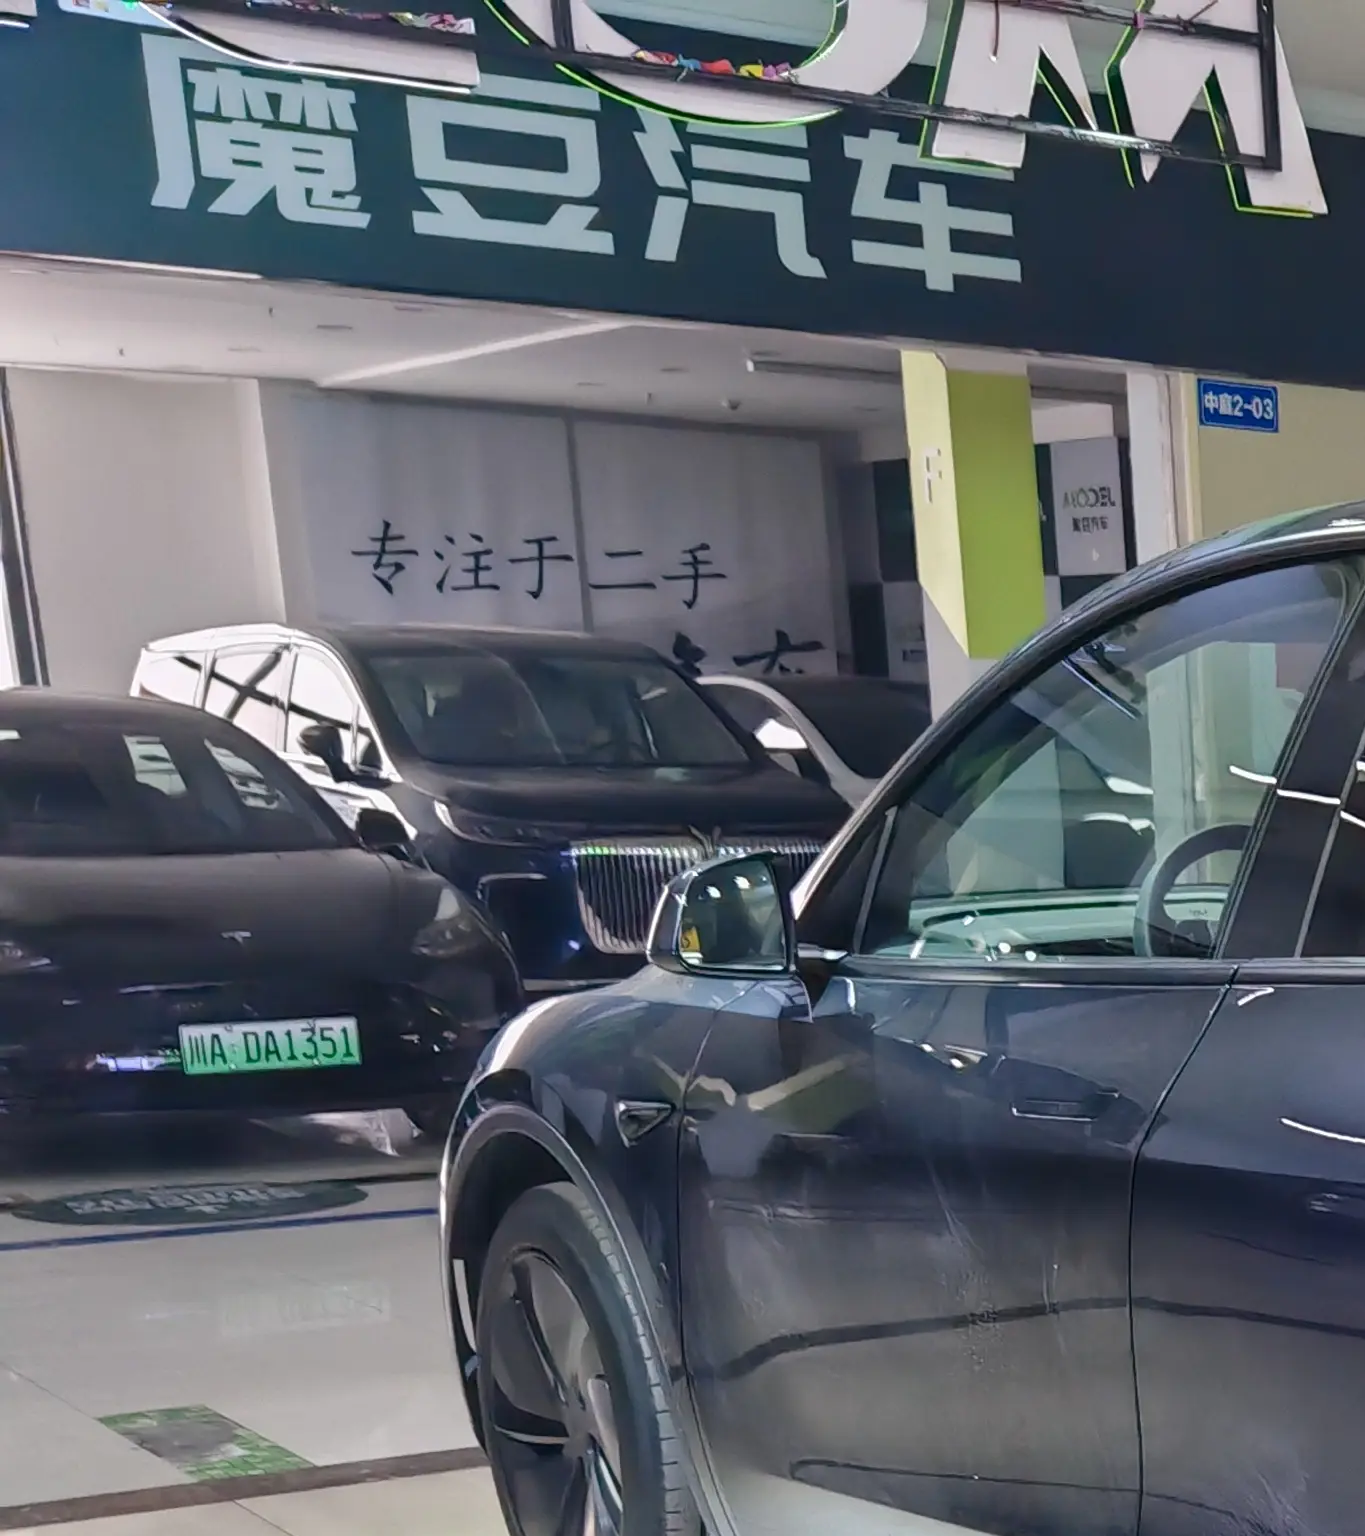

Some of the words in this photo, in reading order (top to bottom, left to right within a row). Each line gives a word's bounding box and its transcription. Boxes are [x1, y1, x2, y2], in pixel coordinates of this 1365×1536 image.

[141, 33, 1021, 291] 魔豆汽车
[1204, 391, 1274, 420] 中庭2-03
[351, 520, 727, 609] 专注于二手
[244, 1026, 356, 1065] DA1351
